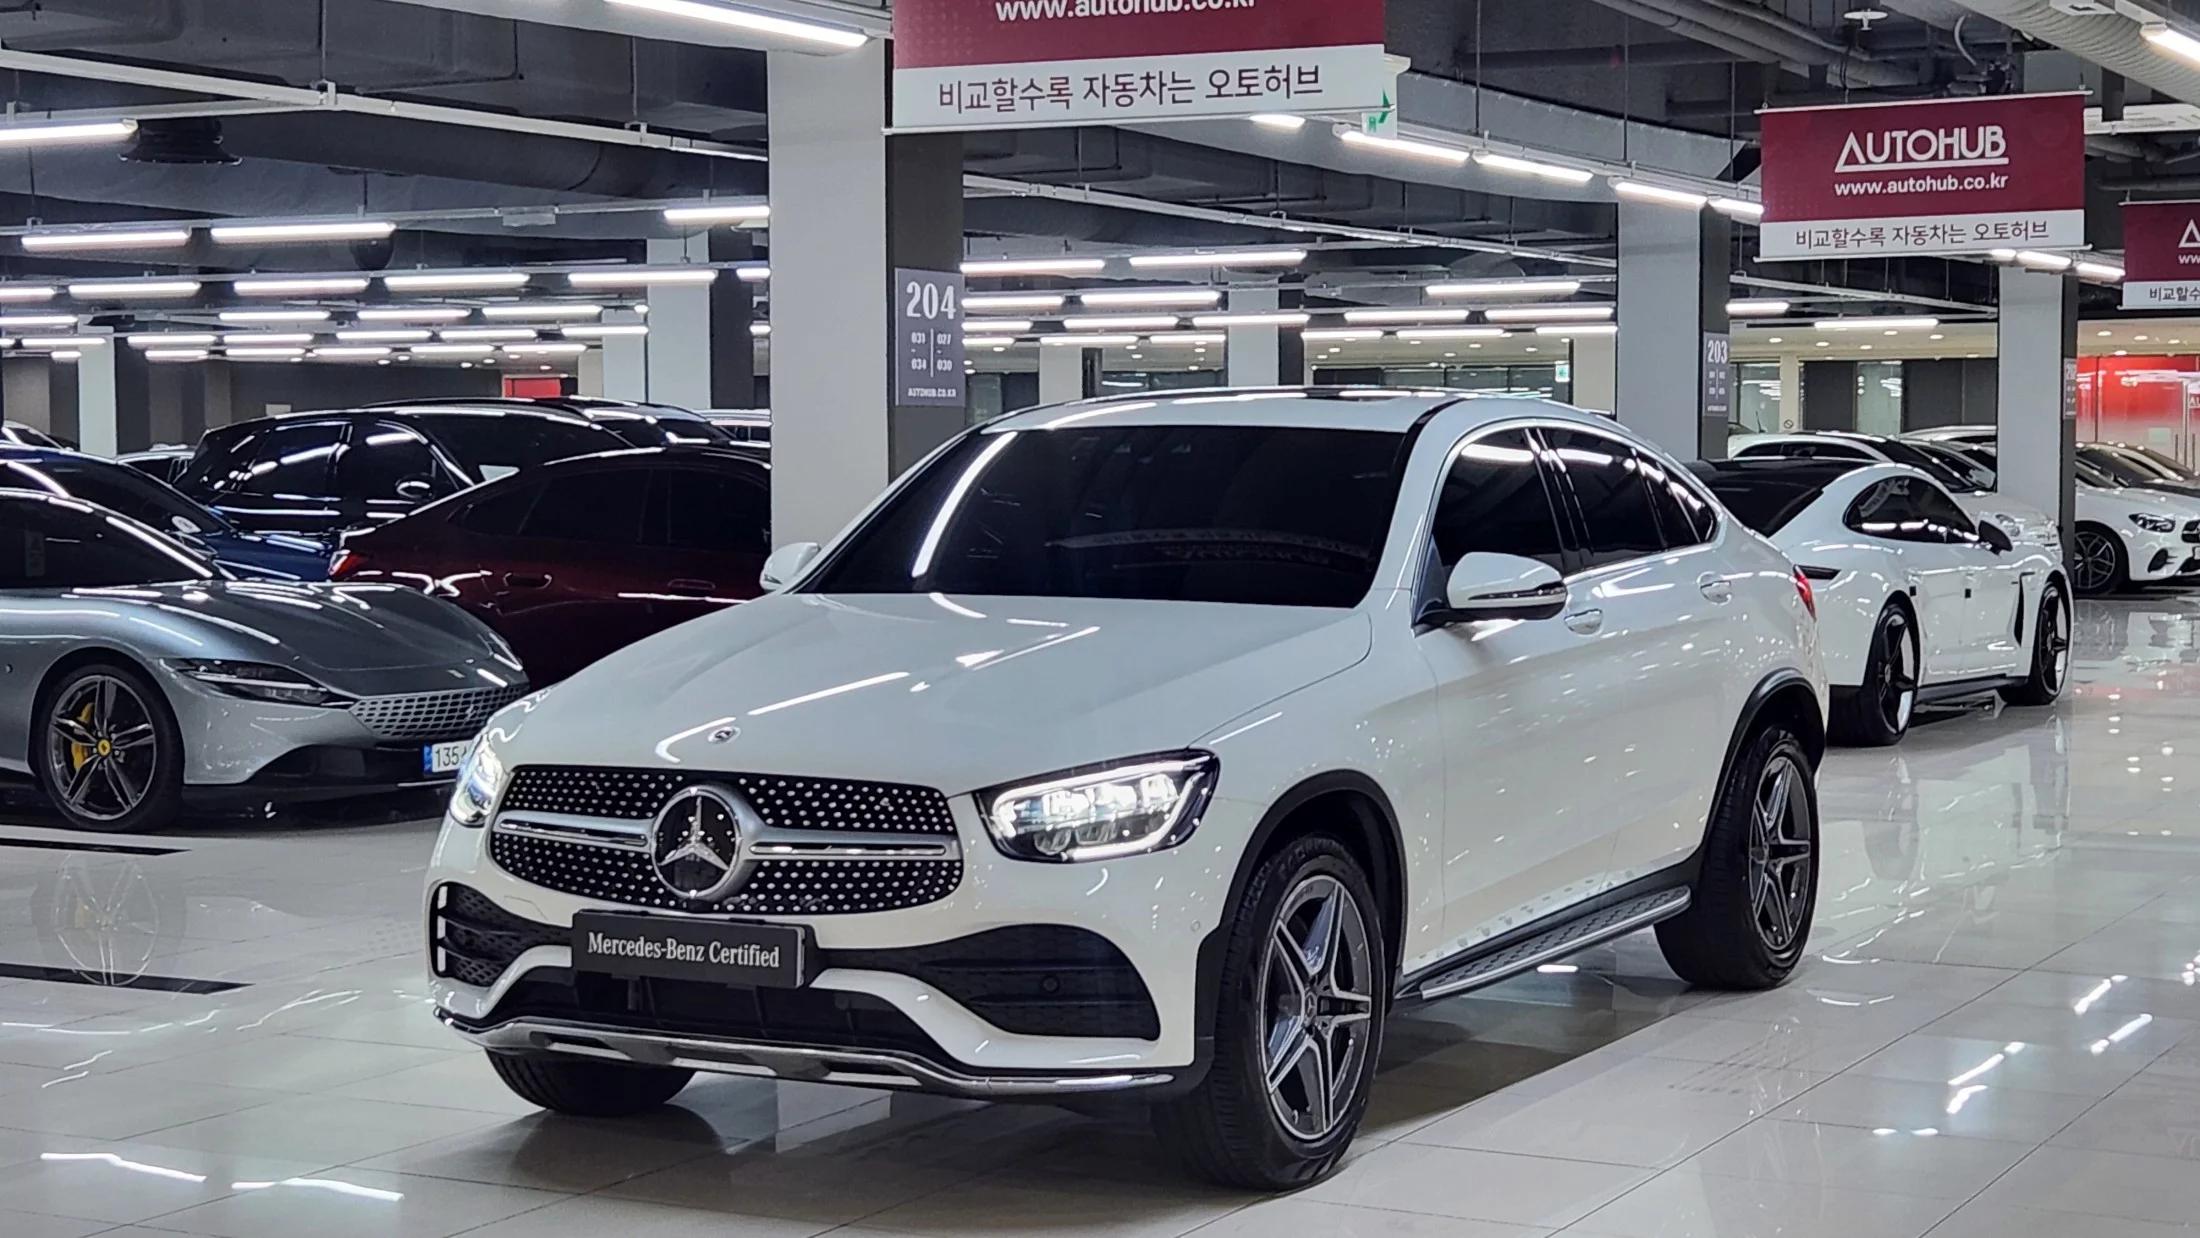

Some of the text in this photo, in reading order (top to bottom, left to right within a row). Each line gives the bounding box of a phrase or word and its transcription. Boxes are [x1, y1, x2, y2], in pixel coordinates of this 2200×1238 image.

[939, 64, 1323, 114] 비교할수록 자동차는 오토허브
[1834, 125, 2009, 173] AUTOHUB
[1834, 172, 2009, 197] www.autohub.co.kr
[1796, 219, 2049, 250] 비교할수록 자동차는 오토허브
[906, 281, 956, 320] 204
[911, 331, 926, 344] 031
[1707, 340, 1728, 364] 203
[588, 932, 780, 968] Mercedes-Benz Certified
